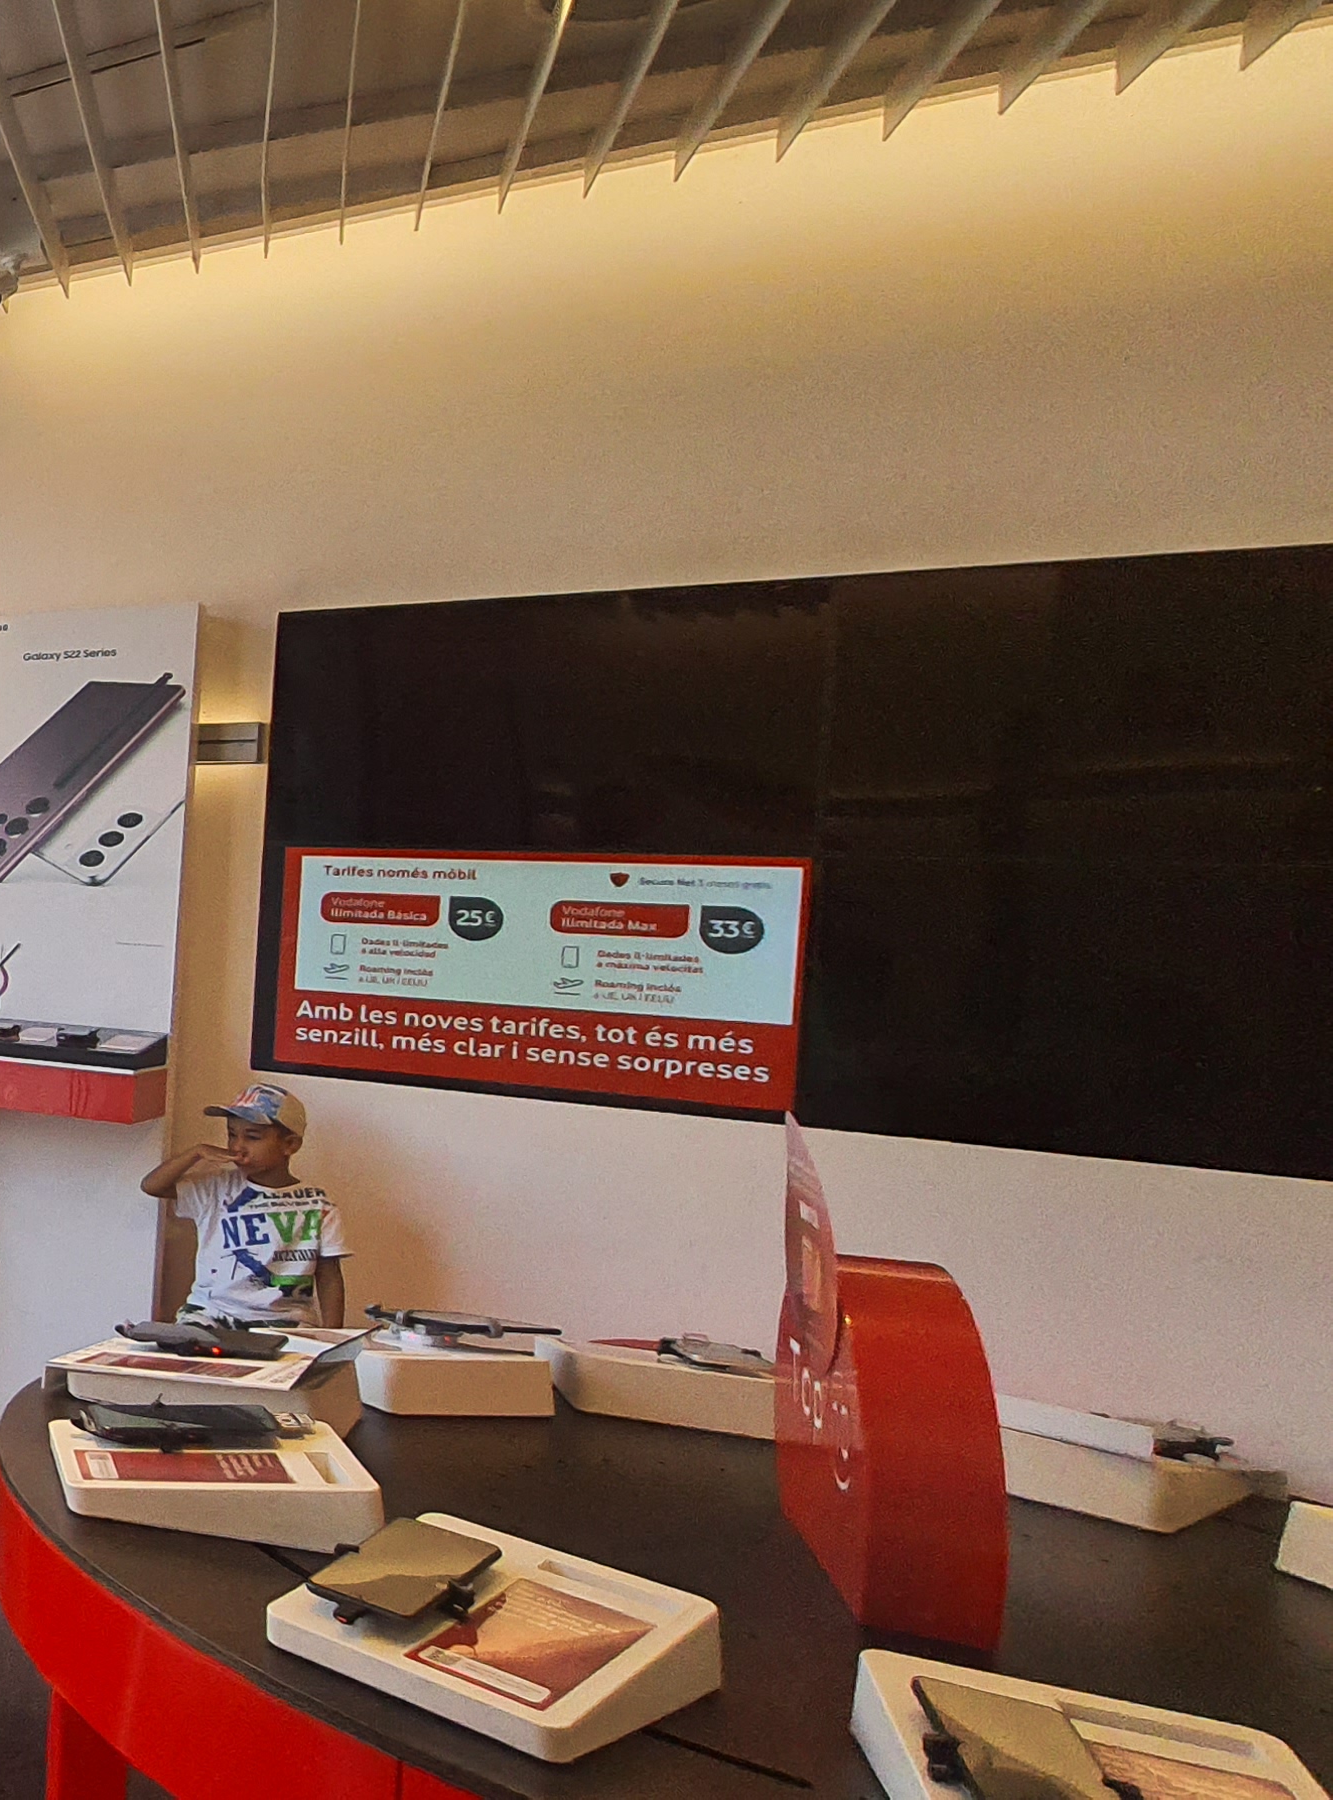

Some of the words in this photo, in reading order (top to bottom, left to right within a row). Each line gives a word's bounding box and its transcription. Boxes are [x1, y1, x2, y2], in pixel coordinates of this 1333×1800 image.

[23, 651, 61, 661] Galaxy
[63, 650, 81, 659] S22
[83, 648, 117, 658] Series
[323, 865, 373, 878] Tarifes
[377, 867, 428, 879] només
[332, 897, 385, 909] Vodafone
[562, 905, 626, 918] Vodafone
[628, 920, 658, 932] Max
[296, 1000, 353, 1021] Amb
[359, 1004, 397, 1025] les
[404, 1012, 484, 1032] noves
[489, 1015, 587, 1042] tarifes,
[594, 1024, 638, 1045] tot
[645, 1026, 679, 1048] és
[687, 1031, 754, 1054] més
[295, 1027, 385, 1050] senzill,
[391, 1033, 446, 1053] més
[453, 1038, 505, 1058] clar
[511, 1042, 519, 1060] i
[525, 1047, 610, 1068] sense
[617, 1055, 770, 1083] sorpreses
